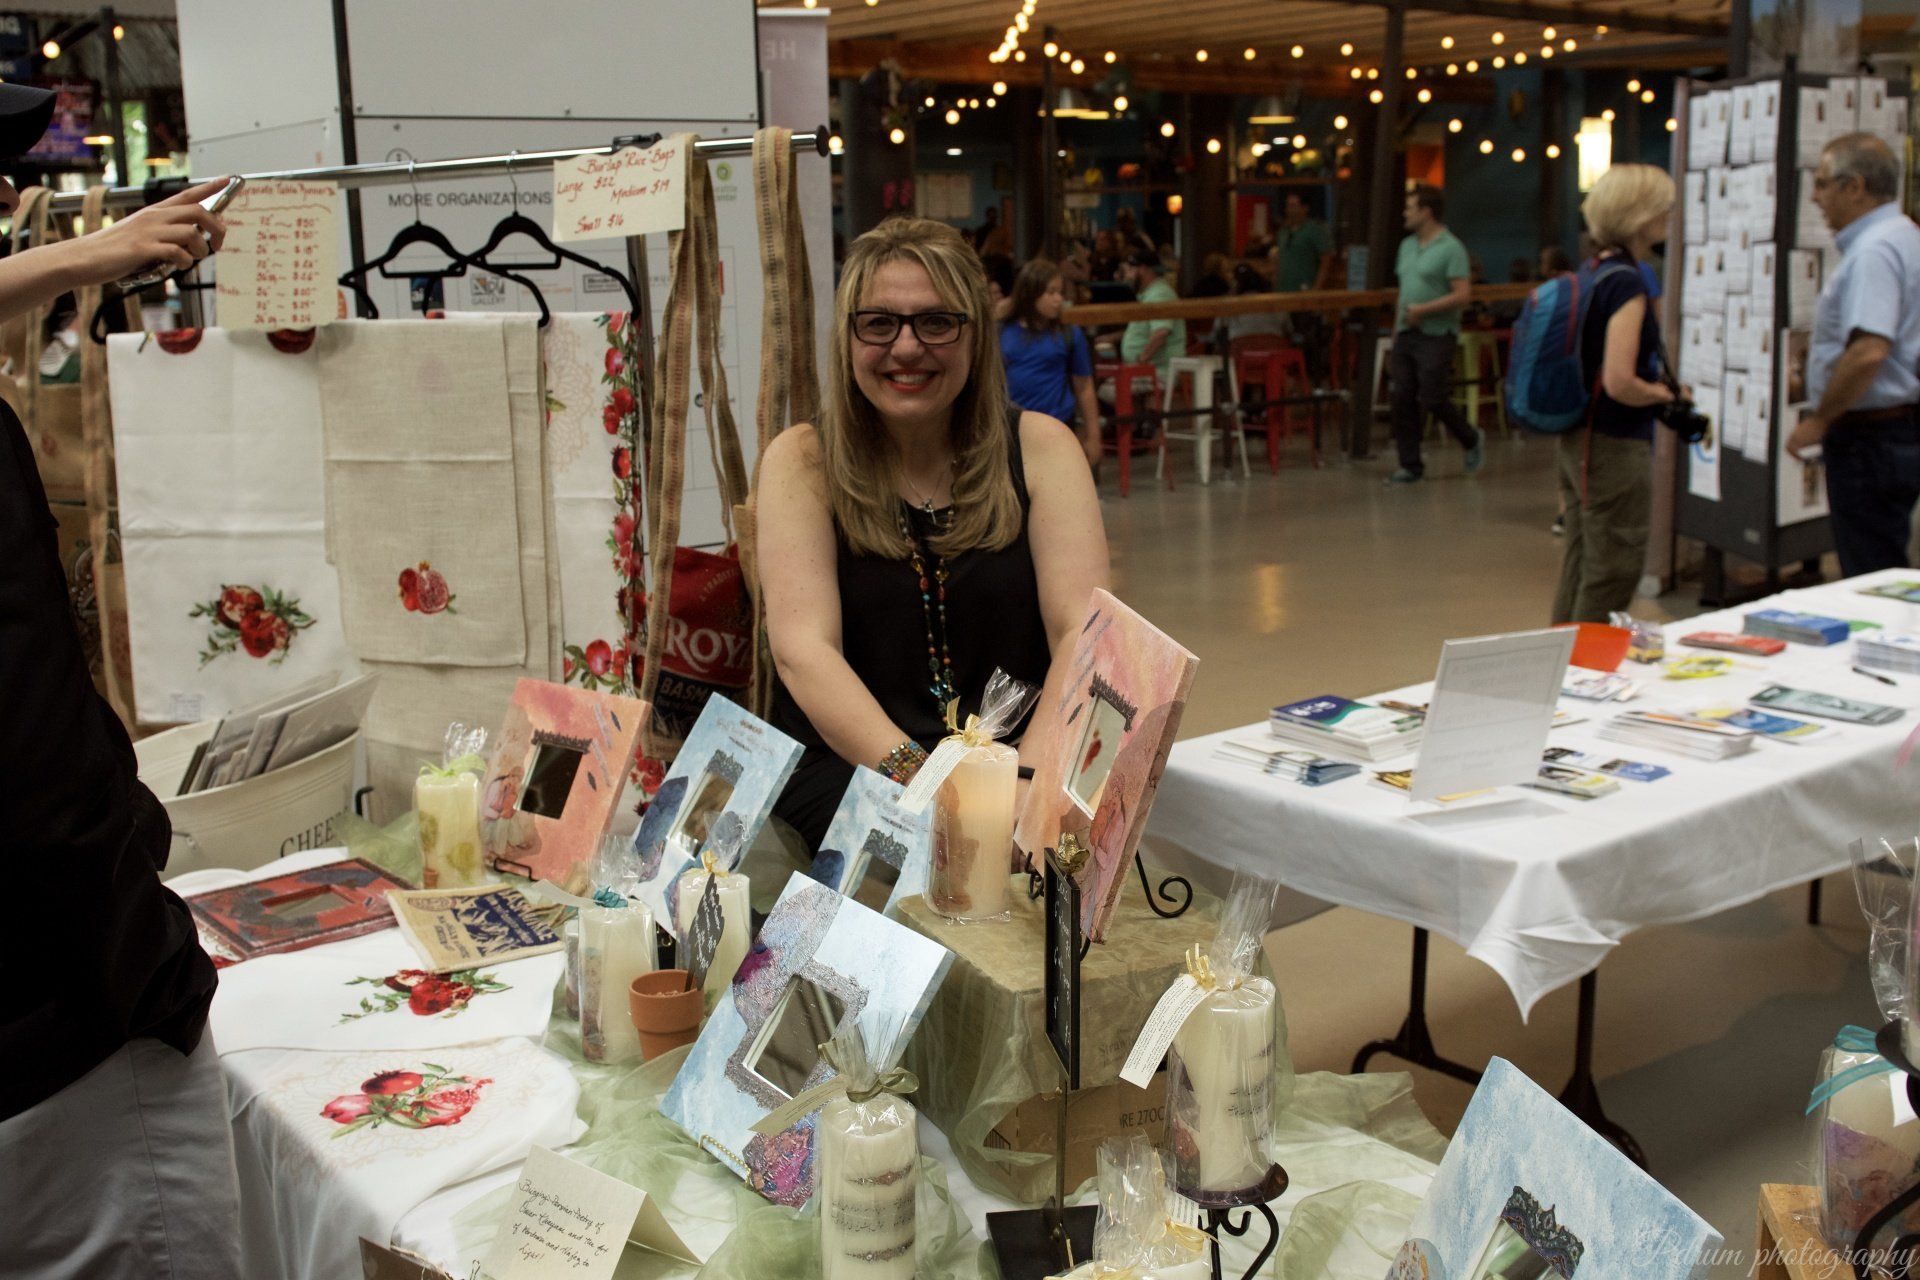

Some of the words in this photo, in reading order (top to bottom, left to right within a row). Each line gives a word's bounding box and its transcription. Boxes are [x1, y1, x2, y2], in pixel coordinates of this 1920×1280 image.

[577, 158, 622, 175] Burlap
[651, 148, 675, 172] Bags
[388, 192, 432, 207] MORE
[436, 190, 552, 208] ORGANIZATIONS
[557, 181, 584, 202] Large
[593, 176, 615, 190] $22
[610, 184, 647, 204] Medium
[574, 216, 601, 234] Small
[607, 213, 623, 228] $16
[512, 1223, 521, 1235] of
[546, 1241, 559, 1251] and
[594, 1222, 604, 1235] of
[568, 1231, 583, 1241] and
[585, 1237, 594, 1247] the
